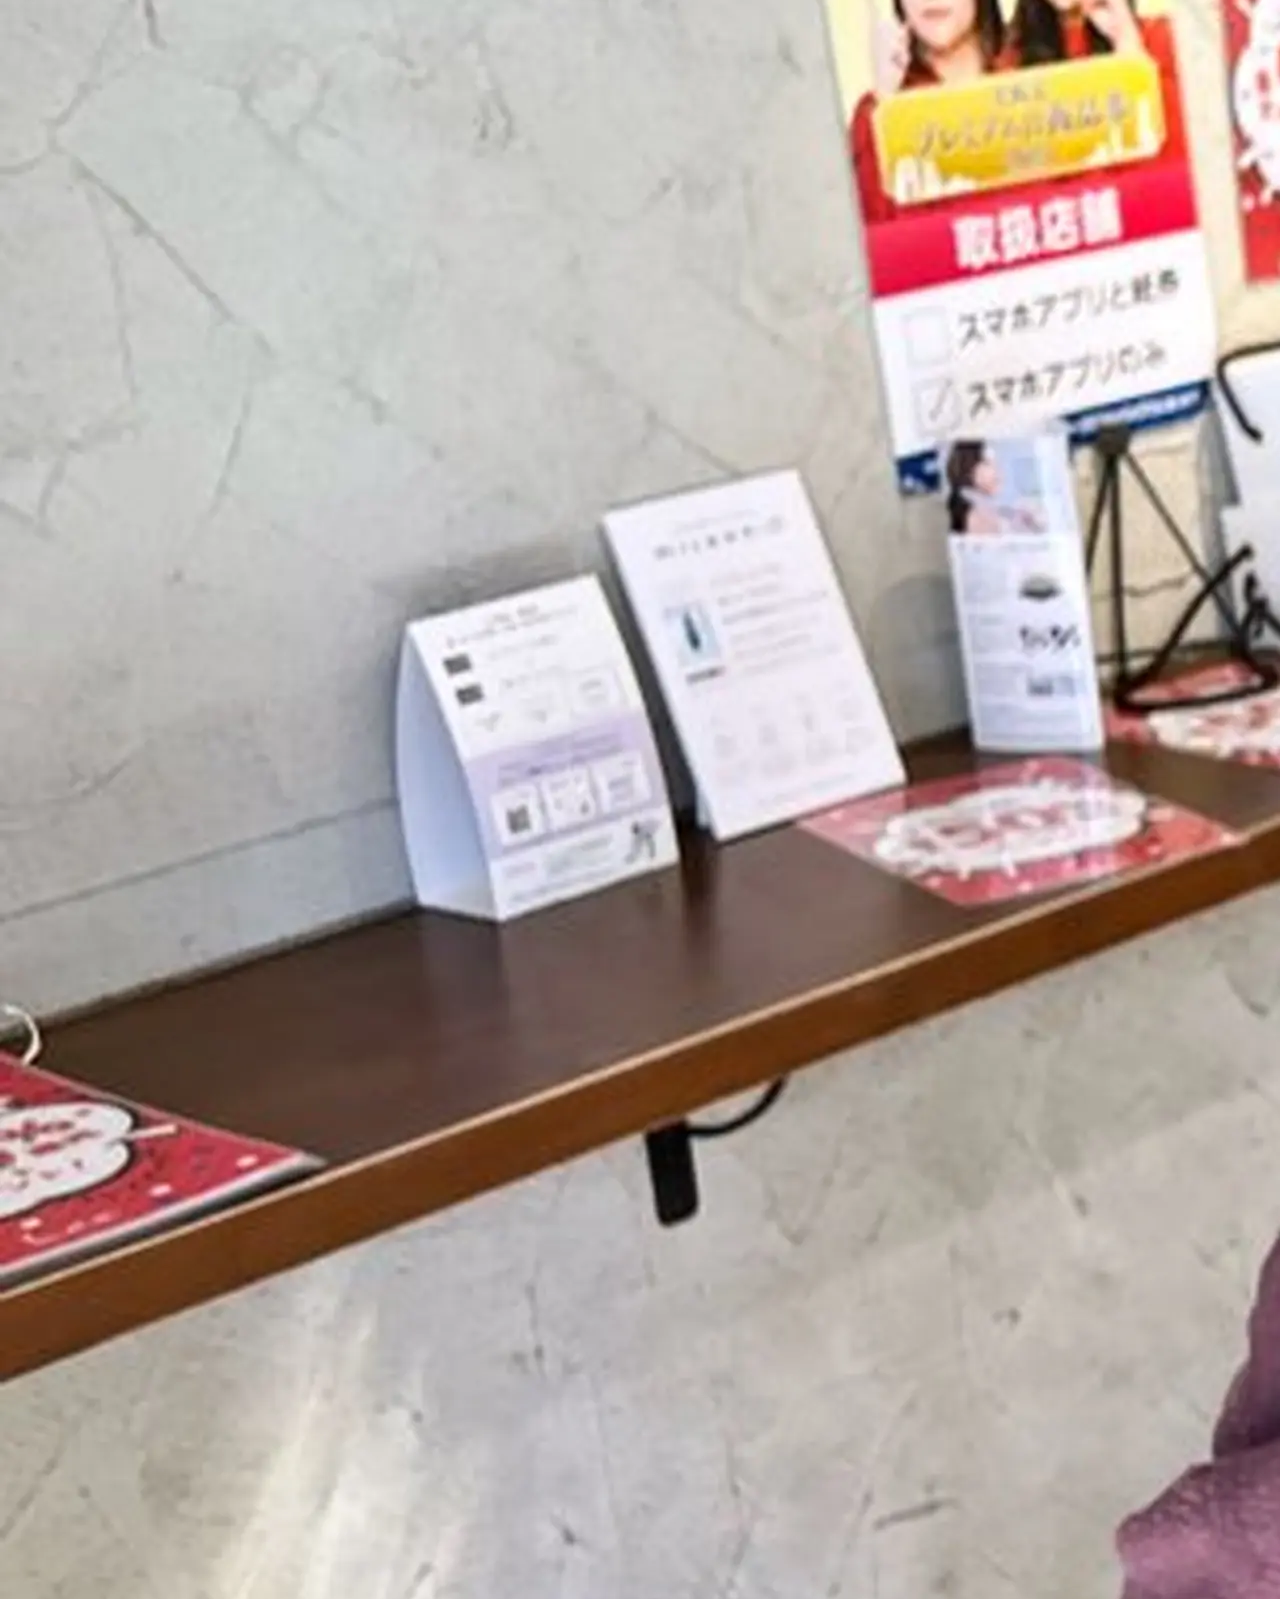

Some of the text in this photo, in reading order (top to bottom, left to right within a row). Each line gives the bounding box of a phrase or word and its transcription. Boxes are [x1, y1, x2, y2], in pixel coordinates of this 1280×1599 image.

[953, 187, 1124, 270] 取扱店舗
[966, 342, 1166, 421] スマホアプリのみ
